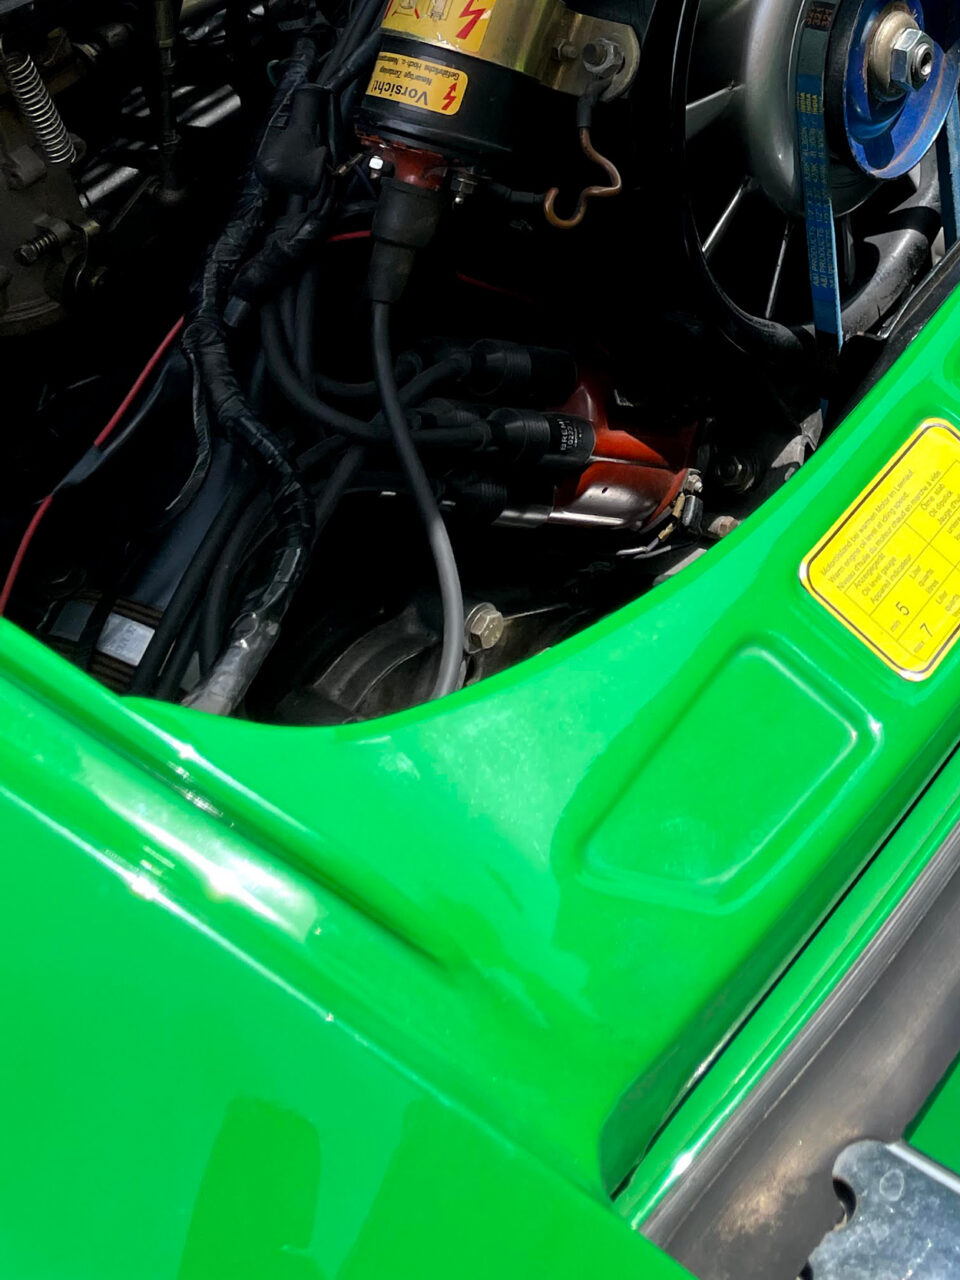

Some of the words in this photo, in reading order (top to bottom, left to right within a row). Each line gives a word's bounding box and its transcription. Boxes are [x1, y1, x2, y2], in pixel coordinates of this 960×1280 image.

[817, 227, 826, 272] PRODUCTS
[874, 496, 891, 513] Motor
[934, 488, 955, 511] dipstick
[936, 506, 953, 526] Jauge
[836, 568, 856, 591] Niveau
[874, 525, 894, 547] moteur
[889, 509, 907, 529] chaud
[909, 484, 929, 505] marche
[827, 564, 845, 583] Warm
[842, 546, 862, 568] engine
[863, 526, 878, 541] level
[867, 572, 882, 588] level
[879, 555, 898, 576] gauge
[908, 563, 923, 580] Liter
[868, 578, 892, 605] Appareil
[934, 589, 949, 605] Liter
[894, 599, 911, 617] 5
[918, 621, 935, 639] 7
